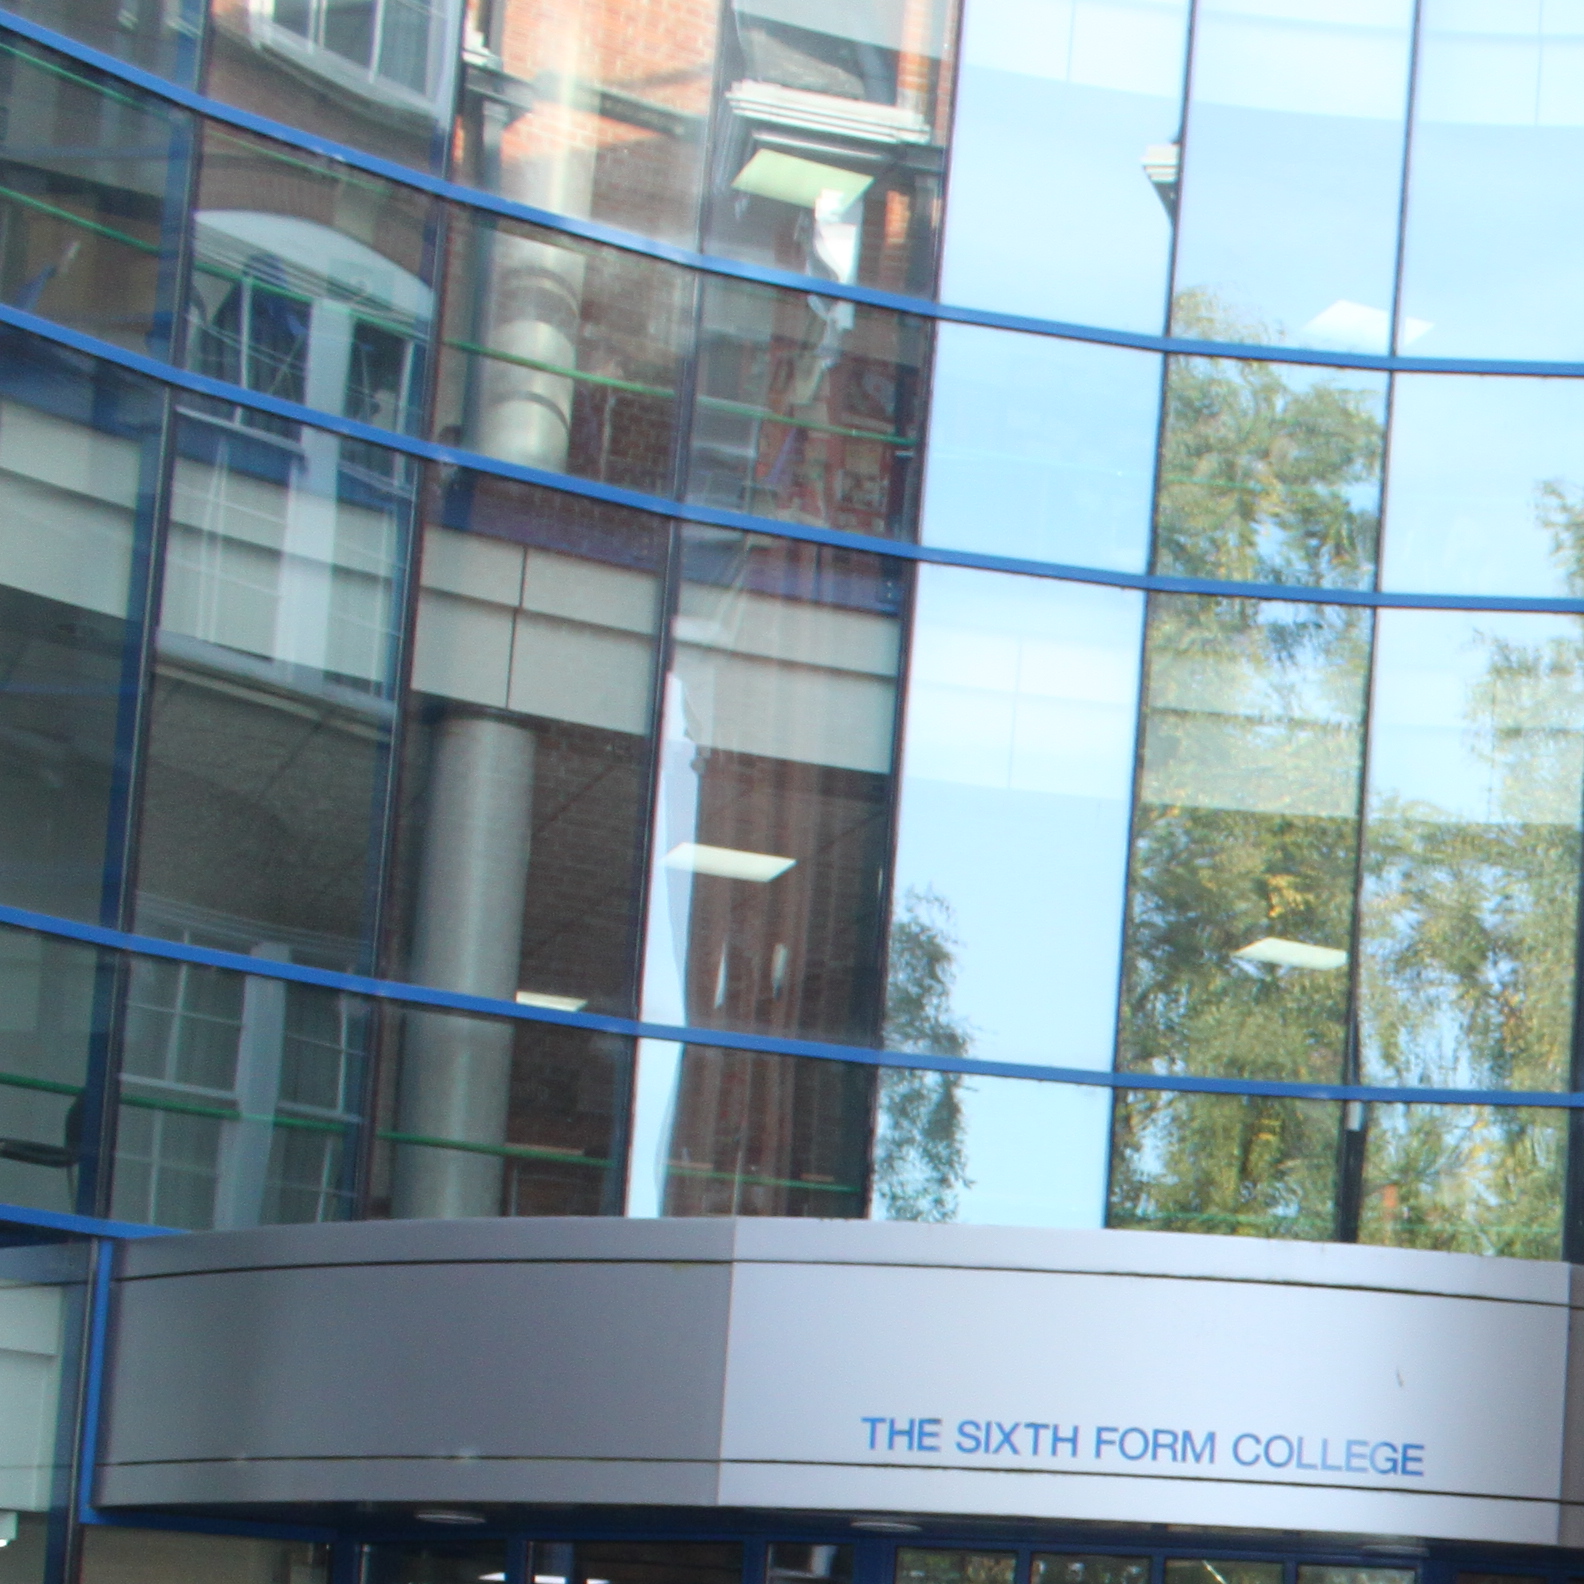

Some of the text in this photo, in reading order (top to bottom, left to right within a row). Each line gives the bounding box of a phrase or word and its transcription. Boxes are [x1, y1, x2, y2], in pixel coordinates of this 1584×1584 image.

[861, 1416, 1426, 1478] THE SIXTH FORM COLLEGE
